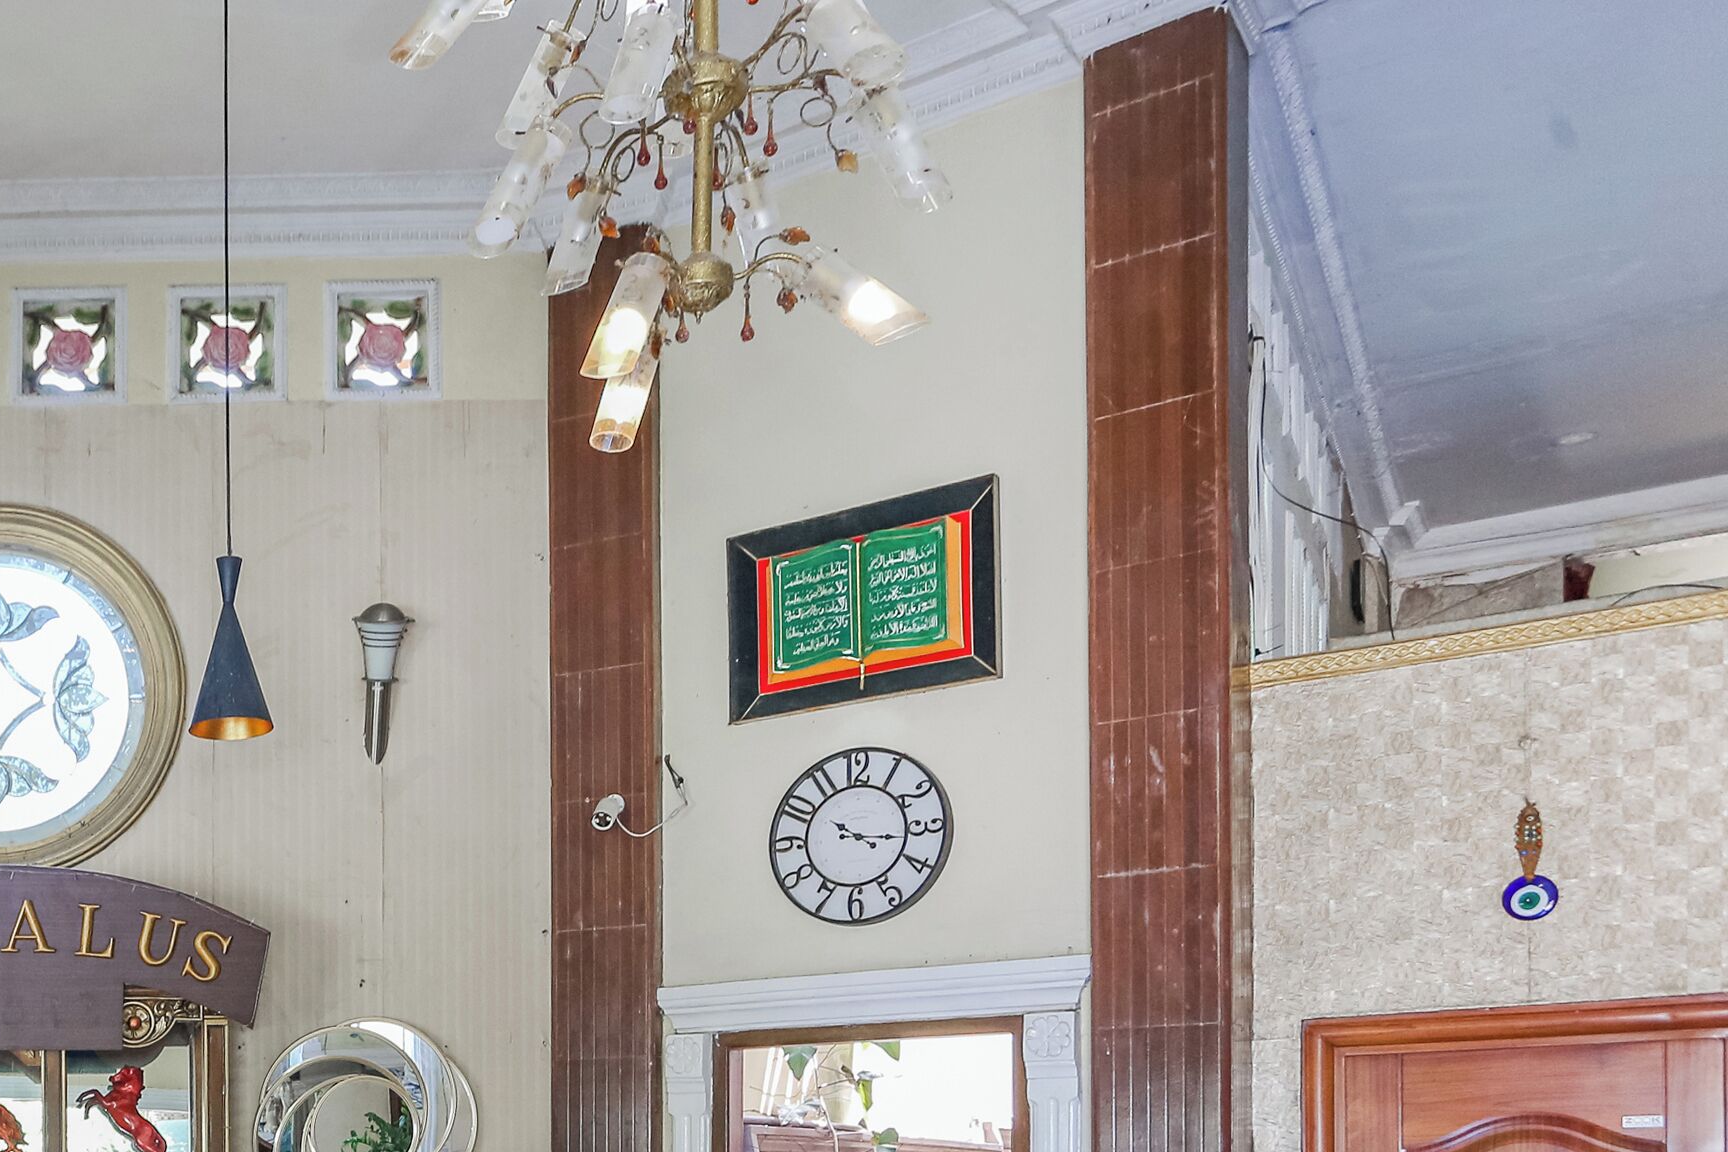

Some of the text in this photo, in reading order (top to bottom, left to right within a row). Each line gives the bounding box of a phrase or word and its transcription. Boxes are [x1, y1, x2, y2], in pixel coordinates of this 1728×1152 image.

[809, 765, 837, 798] 11
[843, 751, 871, 786] 12
[883, 756, 903, 790] 1
[896, 779, 933, 808] 2
[782, 795, 816, 824] 10
[907, 818, 944, 836] 3
[775, 835, 805, 853] 9
[783, 864, 813, 889] 8
[902, 853, 934, 874] 4
[815, 881, 837, 914] 7
[847, 886, 864, 921] 6
[876, 874, 903, 908] 5
